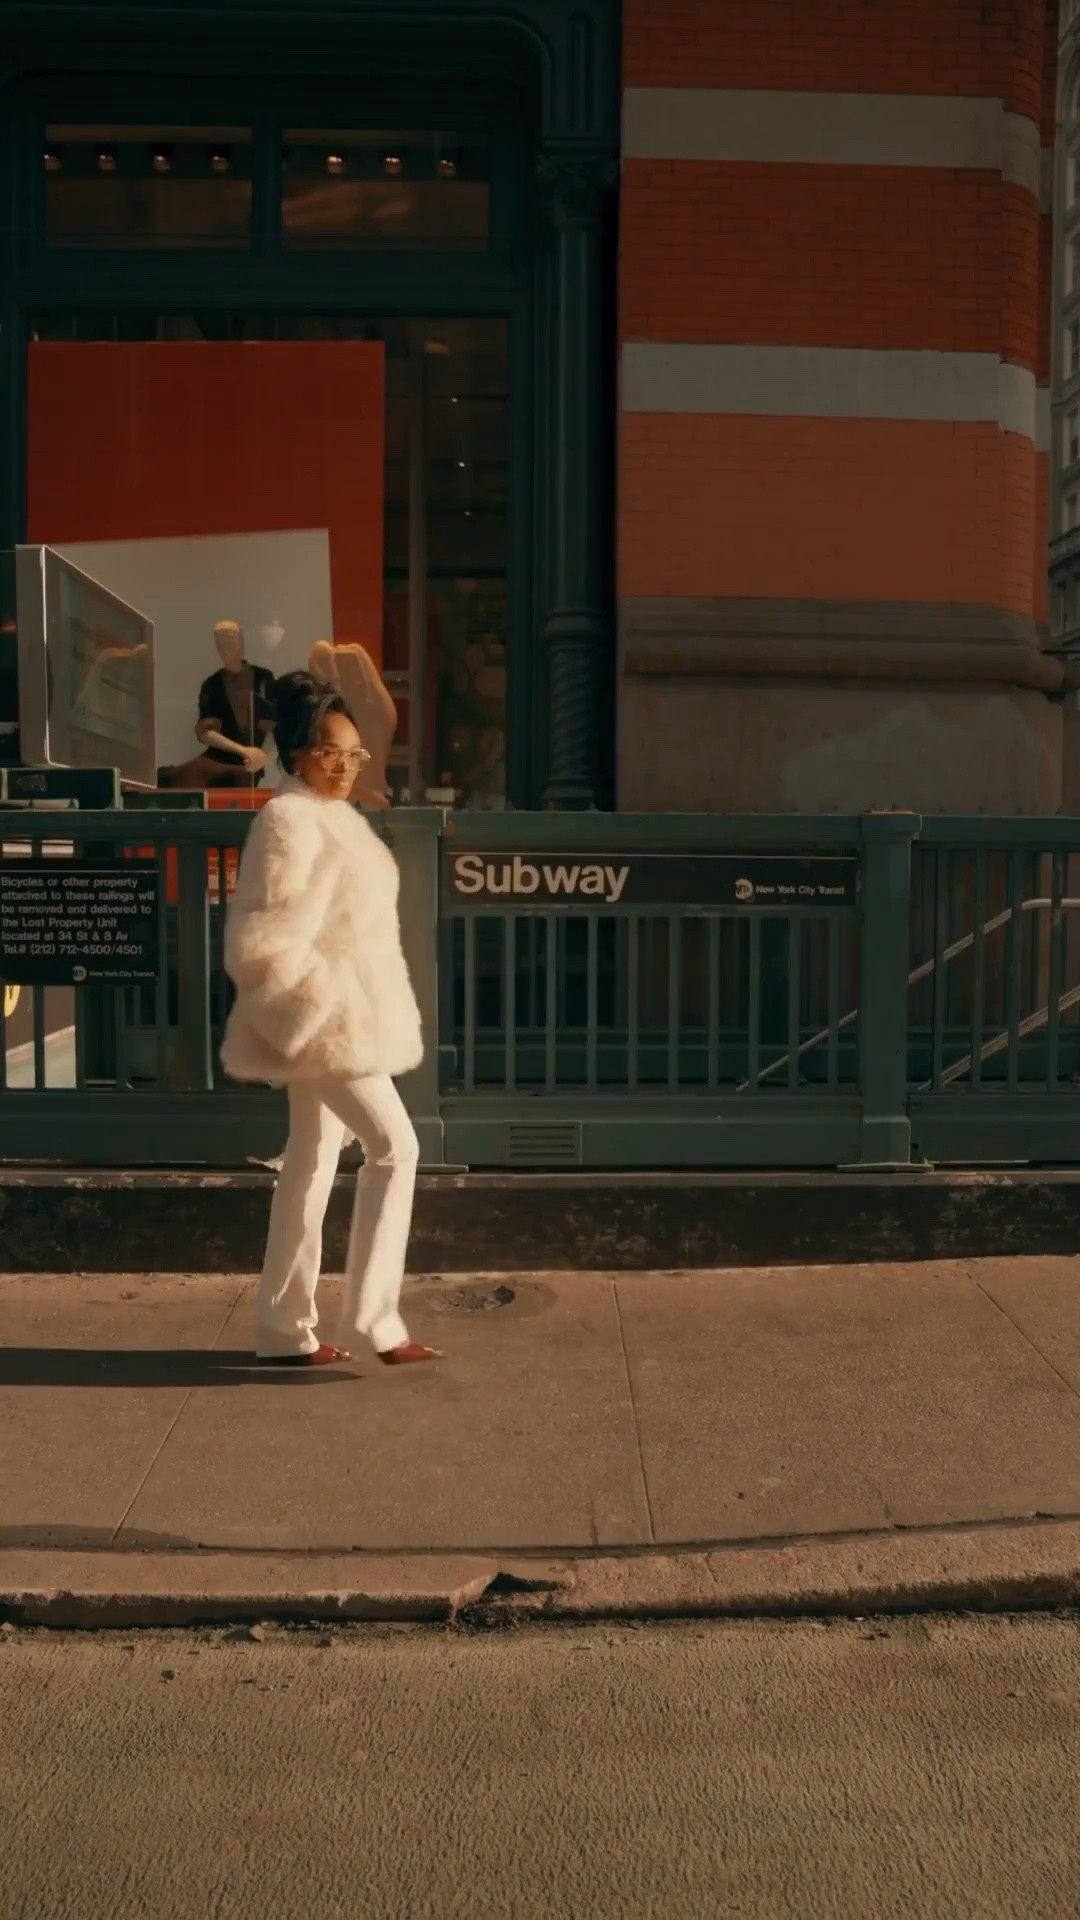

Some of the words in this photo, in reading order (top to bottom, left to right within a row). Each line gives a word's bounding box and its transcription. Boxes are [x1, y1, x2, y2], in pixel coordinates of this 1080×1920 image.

[1, 877, 44, 888] Bicycles
[62, 877, 89, 886] other
[93, 878, 138, 888] property
[454, 855, 630, 902] Subway
[1, 890, 47, 900] attached
[50, 890, 62, 900] to
[65, 890, 95, 900] these
[98, 890, 134, 902] railings
[138, 890, 156, 900] will
[755, 885, 775, 894] New
[777, 885, 796, 894] York
[798, 885, 816, 896] City
[818, 886, 845, 895] Transit
[1, 904, 15, 913] be
[18, 904, 63, 914] removed
[67, 904, 86, 914] and
[90, 904, 137, 914] delivered
[140, 904, 152, 914] to
[2, 917, 18, 927] the
[22, 917, 45, 927] Lost
[49, 917, 93, 929] Property
[97, 917, 118, 928] Unit
[1, 931, 40, 941] located
[44, 931, 54, 941] at
[58, 931, 72, 941] 34
[76, 931, 88, 941] St
[92, 931, 100, 941] &
[104, 931, 112, 941] 8
[115, 931, 129, 941] Av
[30, 944, 56, 955] (212)
[59, 944, 143, 956] 712-4500/4501
[119, 970, 132, 978] City
